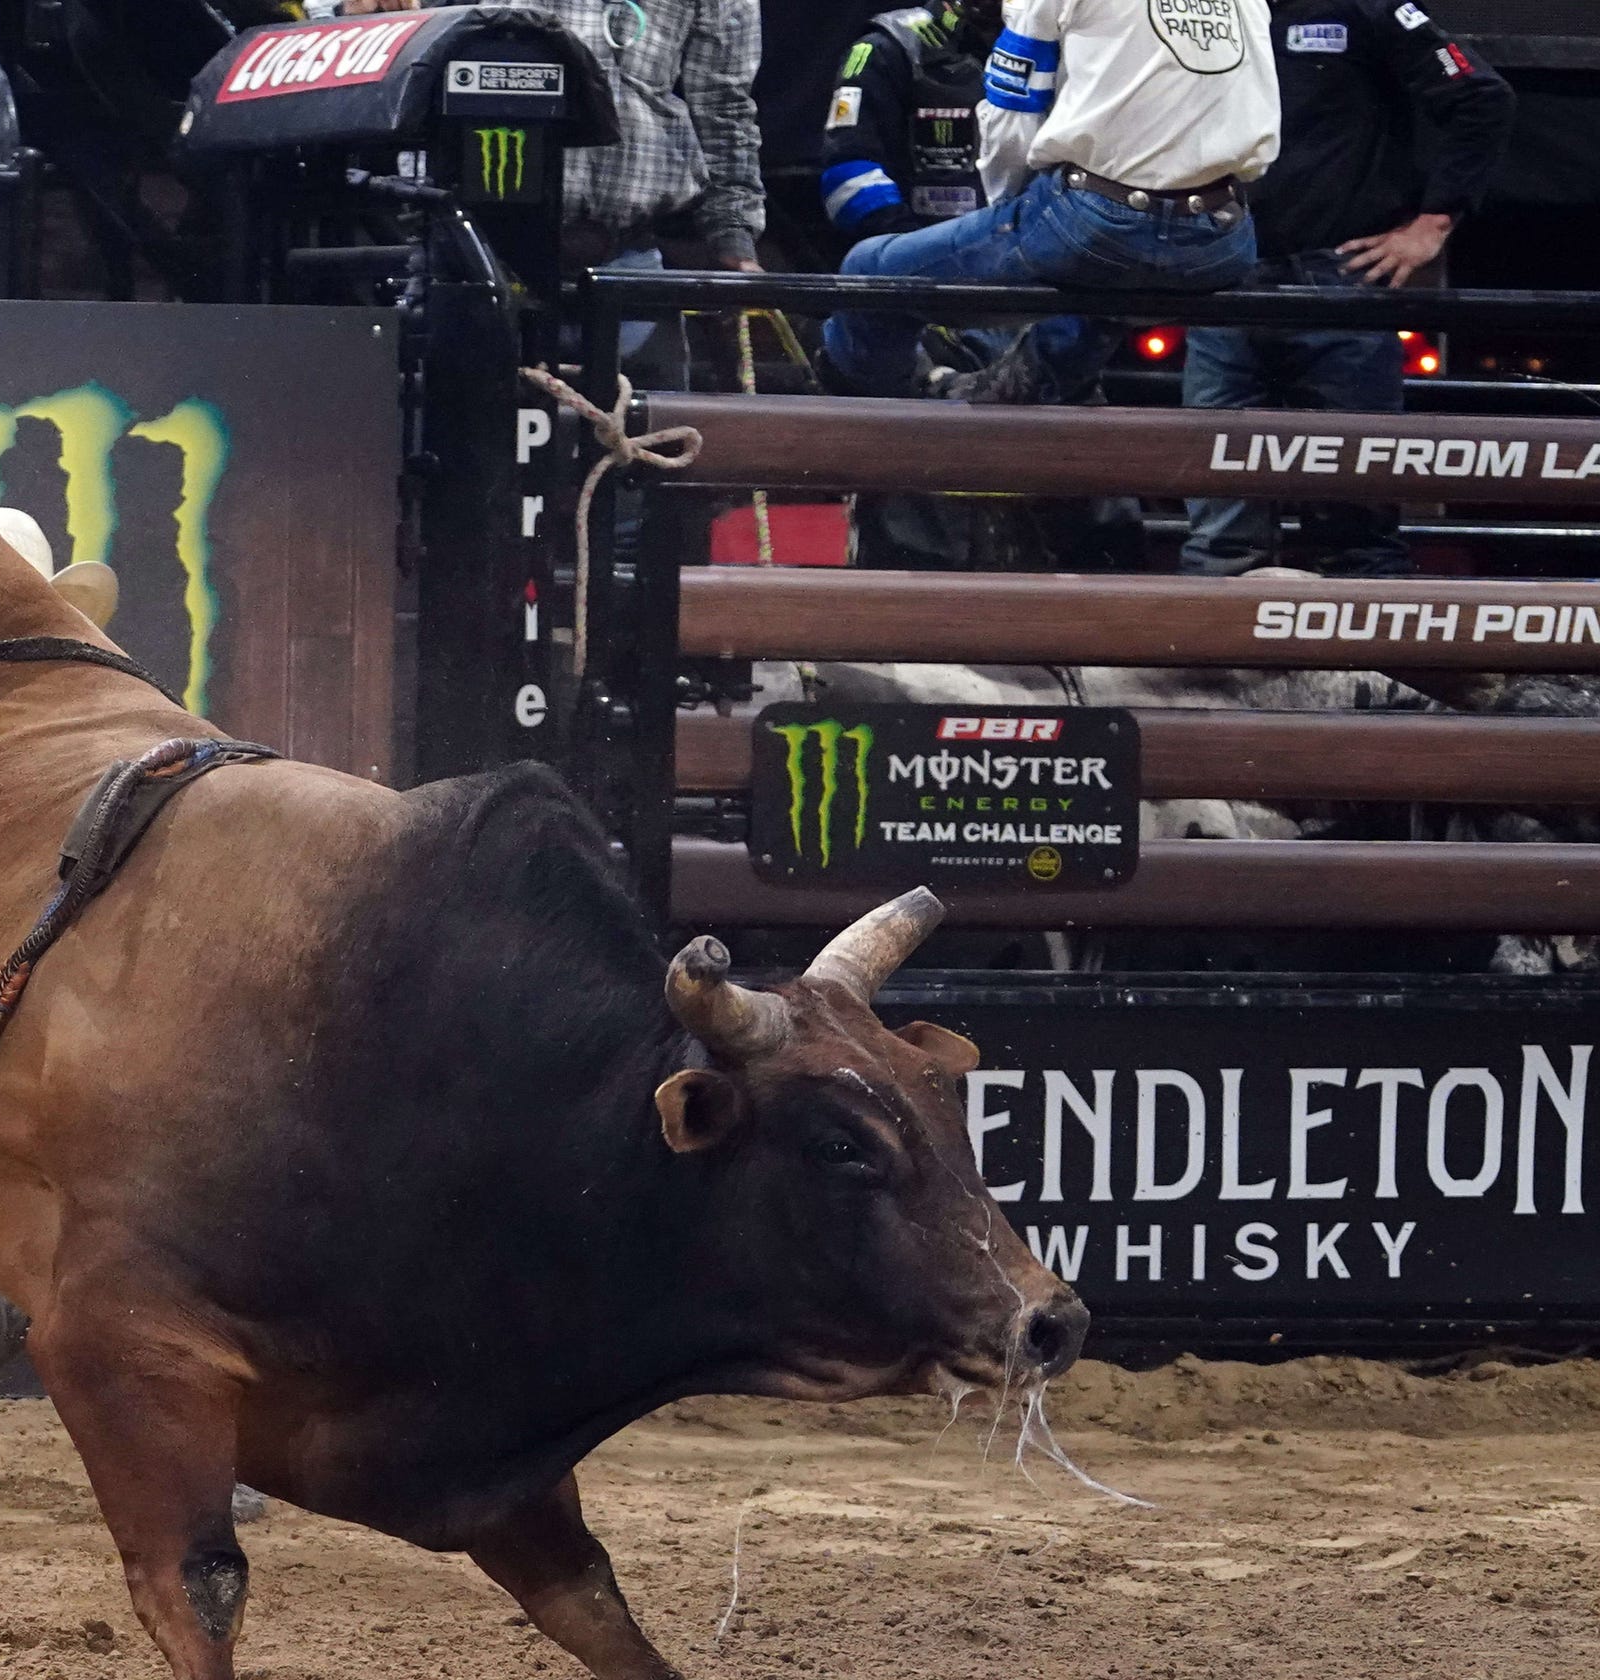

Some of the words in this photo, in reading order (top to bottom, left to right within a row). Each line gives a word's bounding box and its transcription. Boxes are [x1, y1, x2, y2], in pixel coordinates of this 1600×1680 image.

[1160, 0, 1231, 17] BORDER
[1168, 18, 1238, 43] PATROL
[228, 27, 363, 92] LUCAS
[334, 20, 417, 78] OIL
[481, 67, 506, 78] CBS
[508, 68, 559, 79] SPORTS
[481, 79, 546, 89] NETWORK
[1210, 434, 1344, 473] LIVE
[1355, 438, 1529, 478] FROM
[1541, 442, 1600, 479] LA
[1253, 602, 1460, 642] SOUTH
[1472, 606, 1600, 644] POIN
[941, 718, 1060, 740] PBR
[888, 749, 1112, 790] MONSTER
[920, 797, 1073, 811] ENERGY
[880, 822, 956, 843] TEAM
[963, 822, 1122, 845] CHALLENGE
[1027, 1222, 1417, 1281] WHISKY
